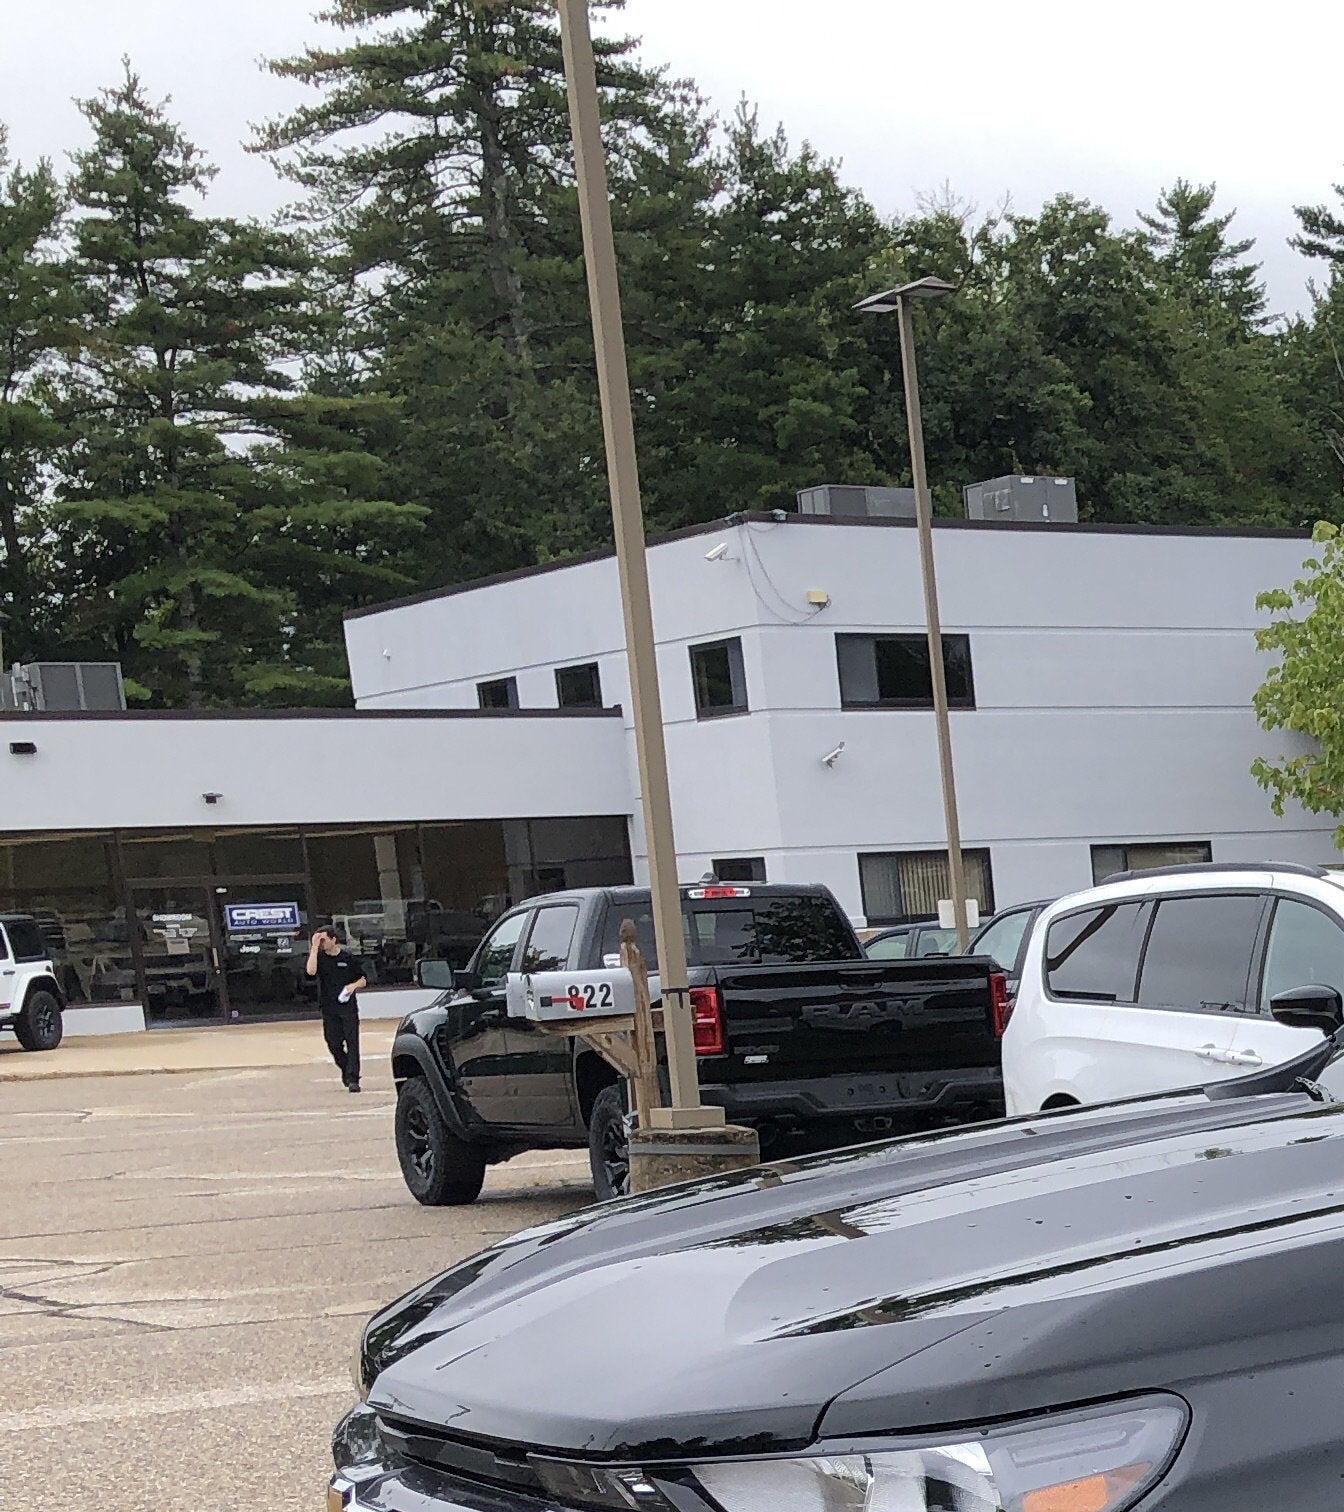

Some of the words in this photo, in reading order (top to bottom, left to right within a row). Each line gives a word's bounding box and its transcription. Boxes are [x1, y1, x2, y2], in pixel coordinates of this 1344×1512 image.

[231, 907, 293, 921] CREST
[239, 944, 261, 954] Jeep
[568, 983, 613, 1010] 822
[801, 1000, 925, 1019] RAM
